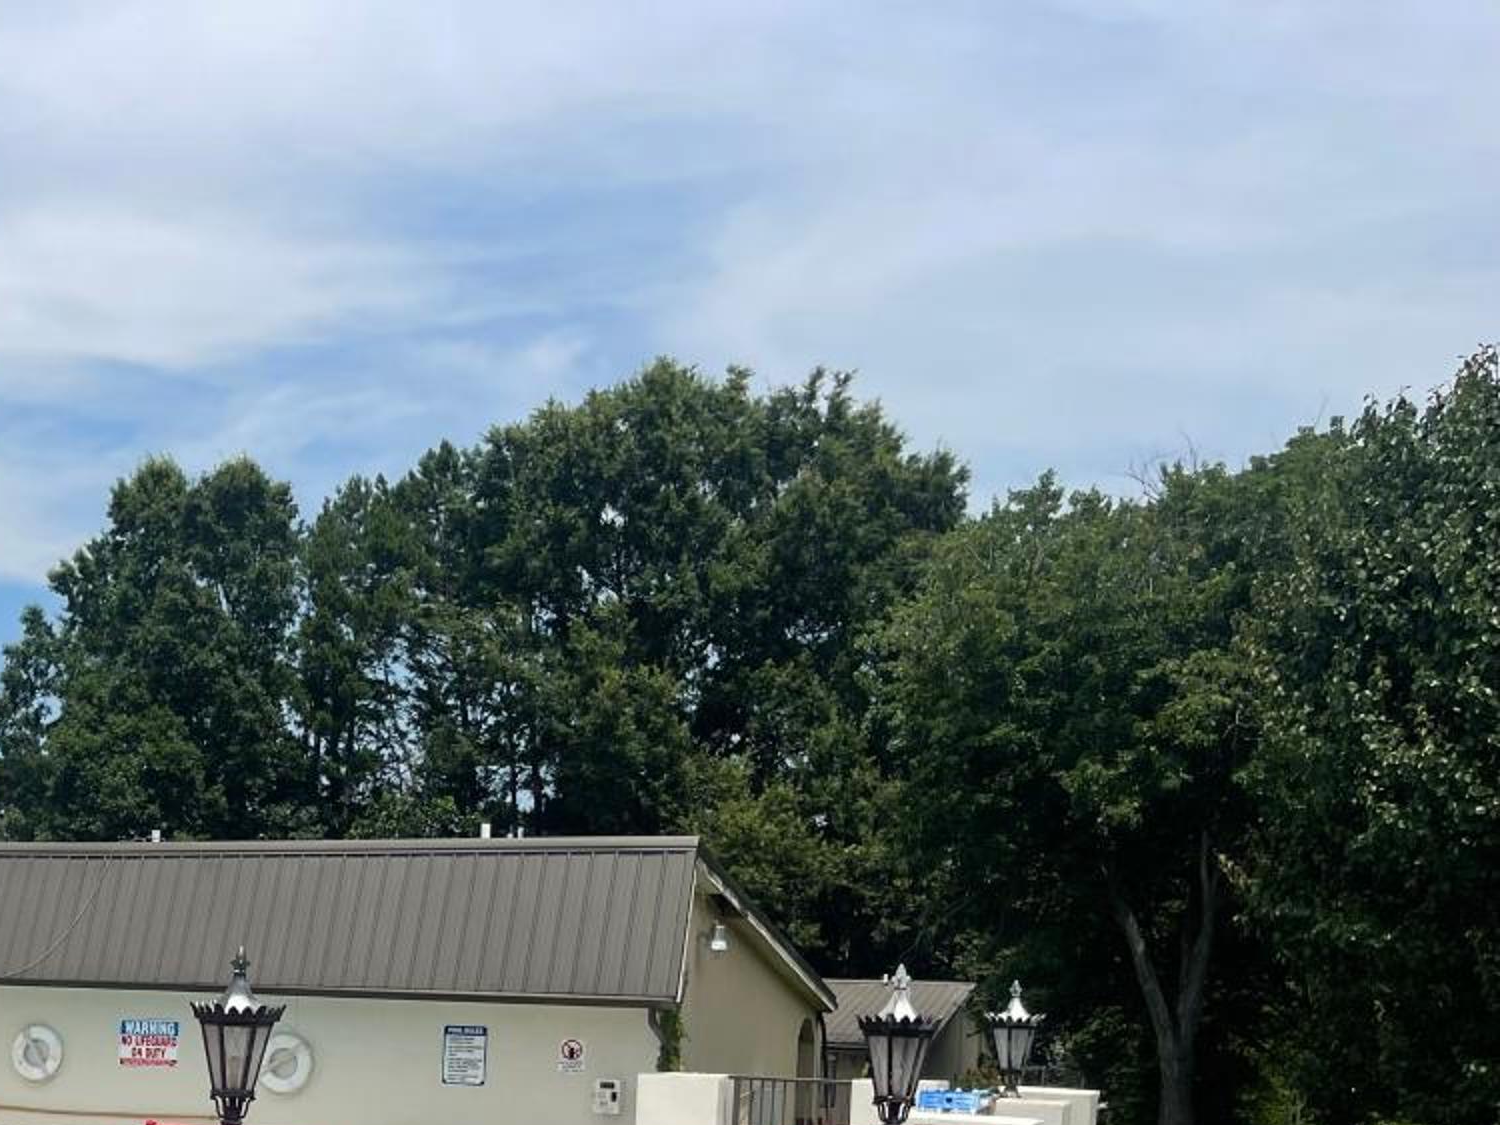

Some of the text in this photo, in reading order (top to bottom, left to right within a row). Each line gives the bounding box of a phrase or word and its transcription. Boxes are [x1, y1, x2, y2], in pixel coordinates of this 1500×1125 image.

[125, 1021, 175, 1035] WARNING
[122, 1035, 178, 1048] NO LIFEGUARD
[132, 1047, 165, 1059] ON DUTY
